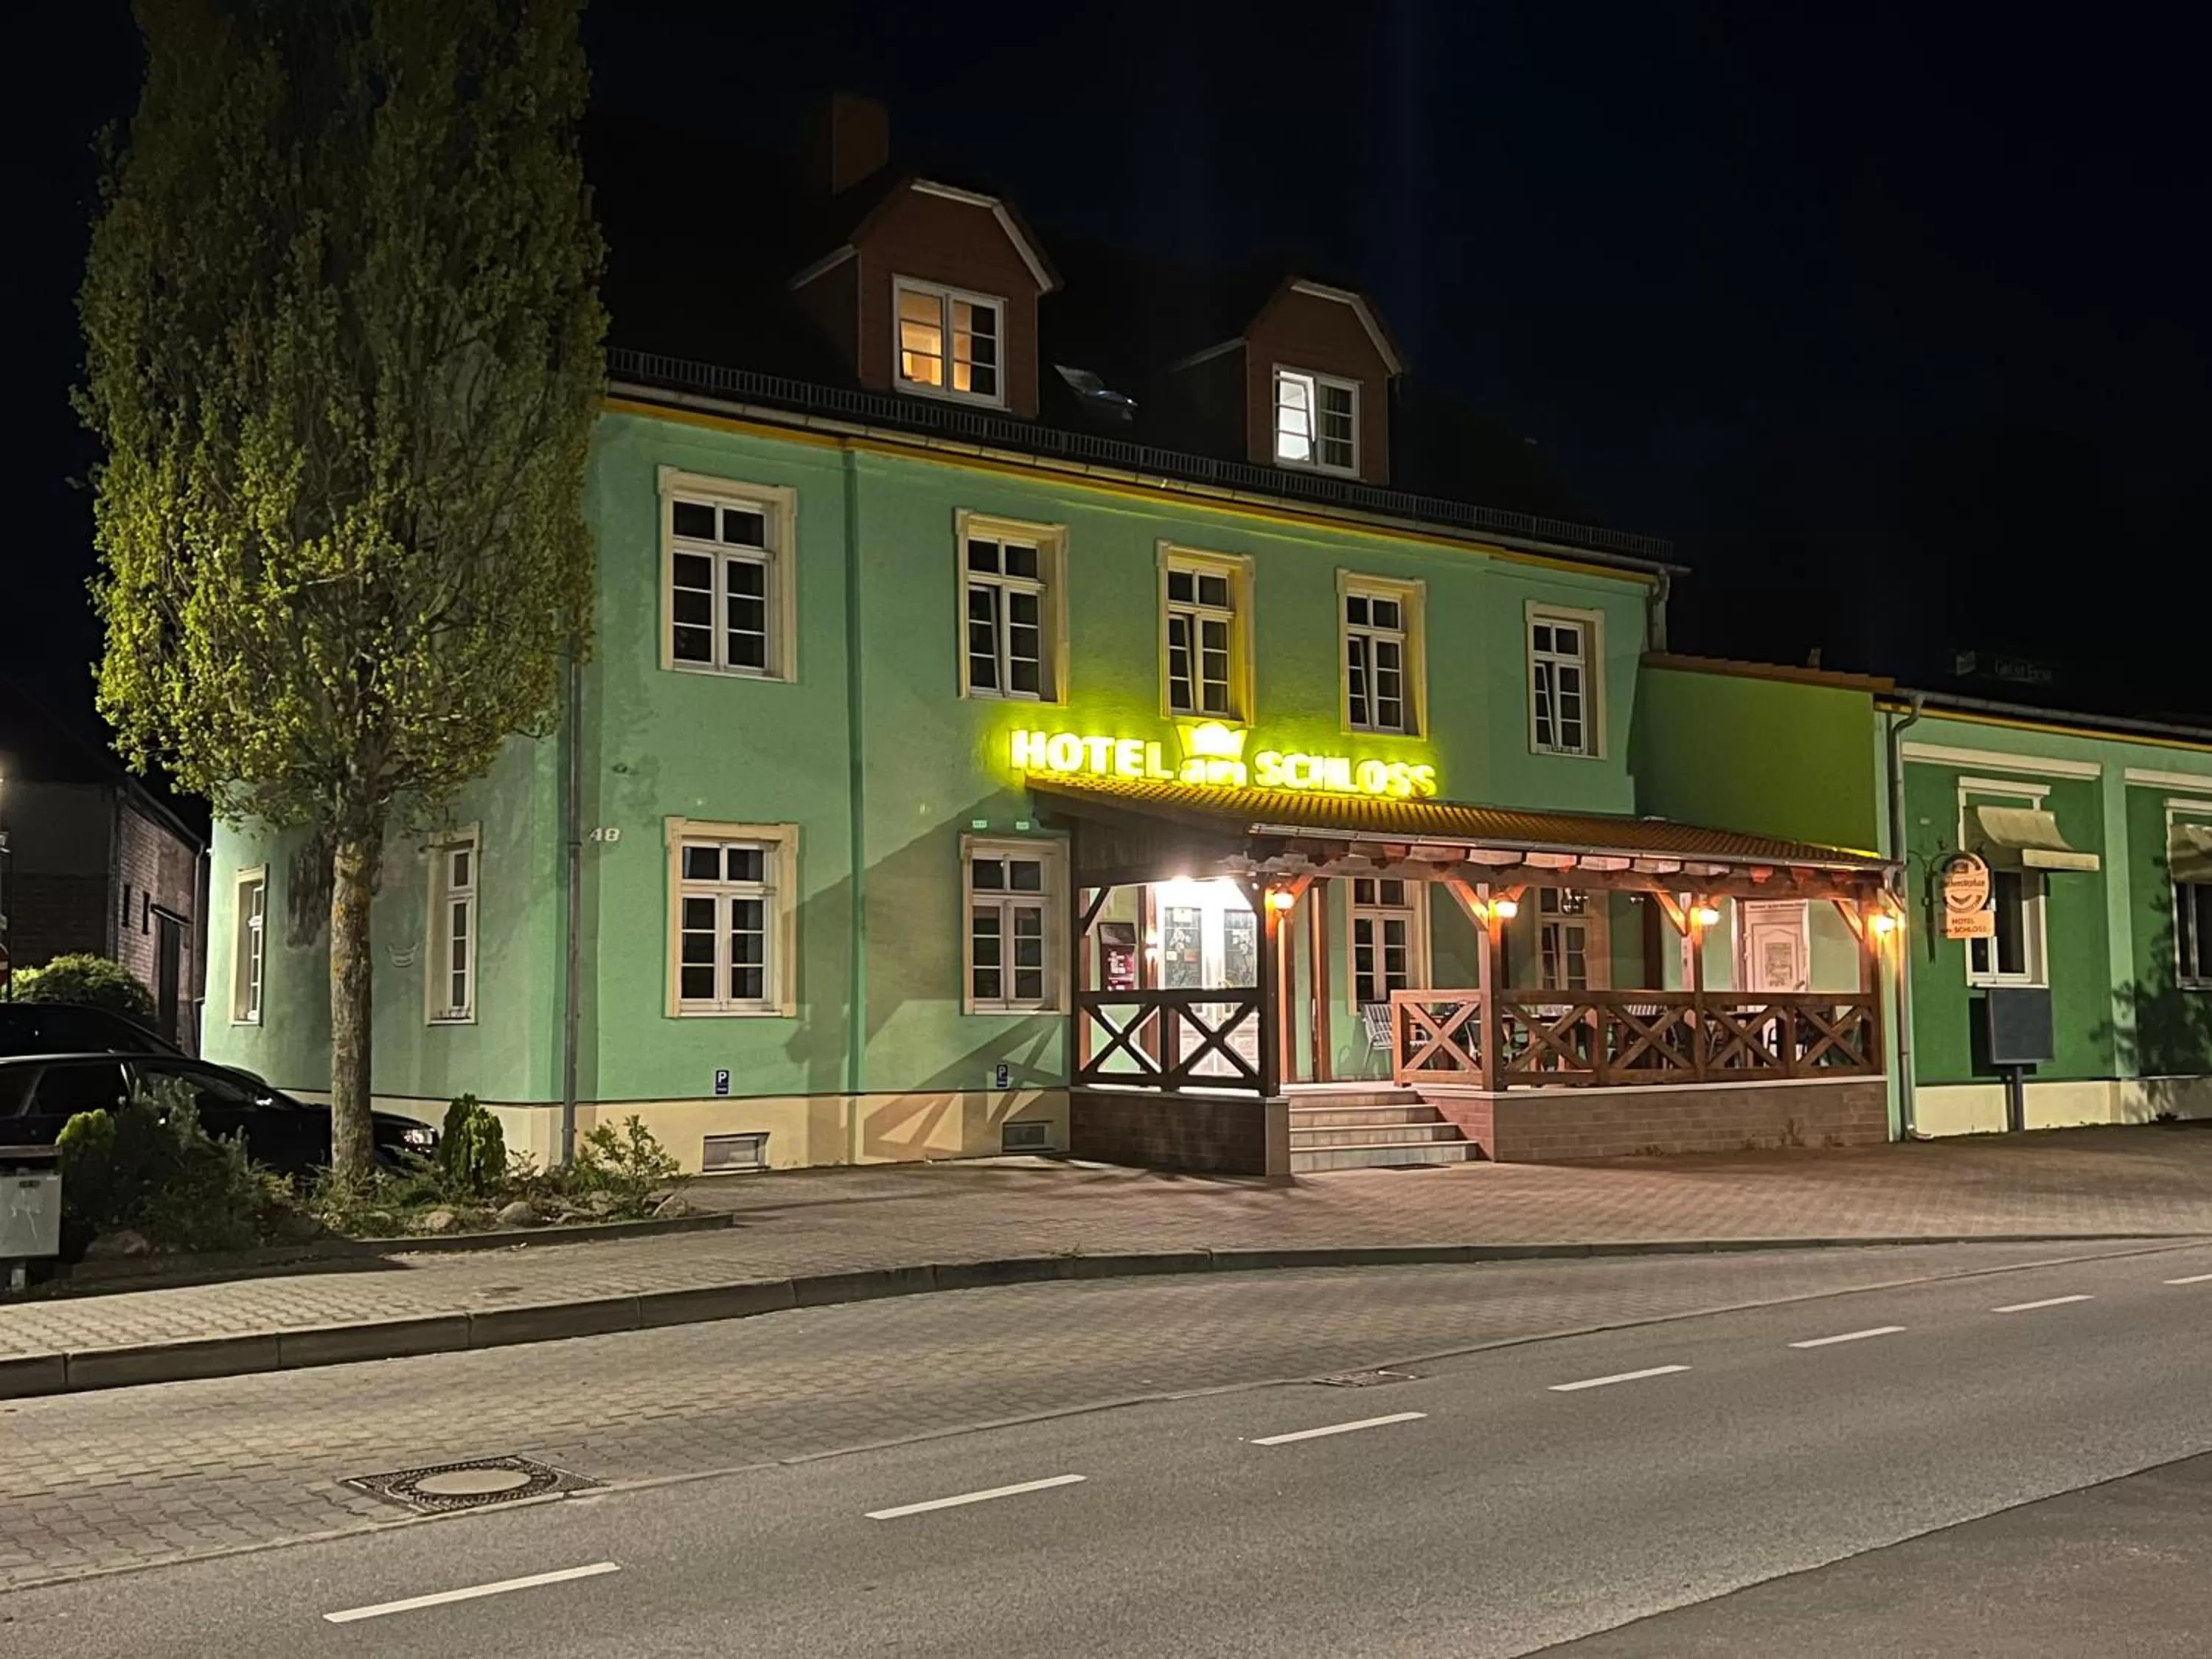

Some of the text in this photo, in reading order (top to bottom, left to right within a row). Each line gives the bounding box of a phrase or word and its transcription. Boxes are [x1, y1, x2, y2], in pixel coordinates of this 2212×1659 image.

[1011, 728, 1436, 797] HOTEL am SCHLOSS
[718, 1071, 727, 1082] P
[998, 1066, 1006, 1077] P
